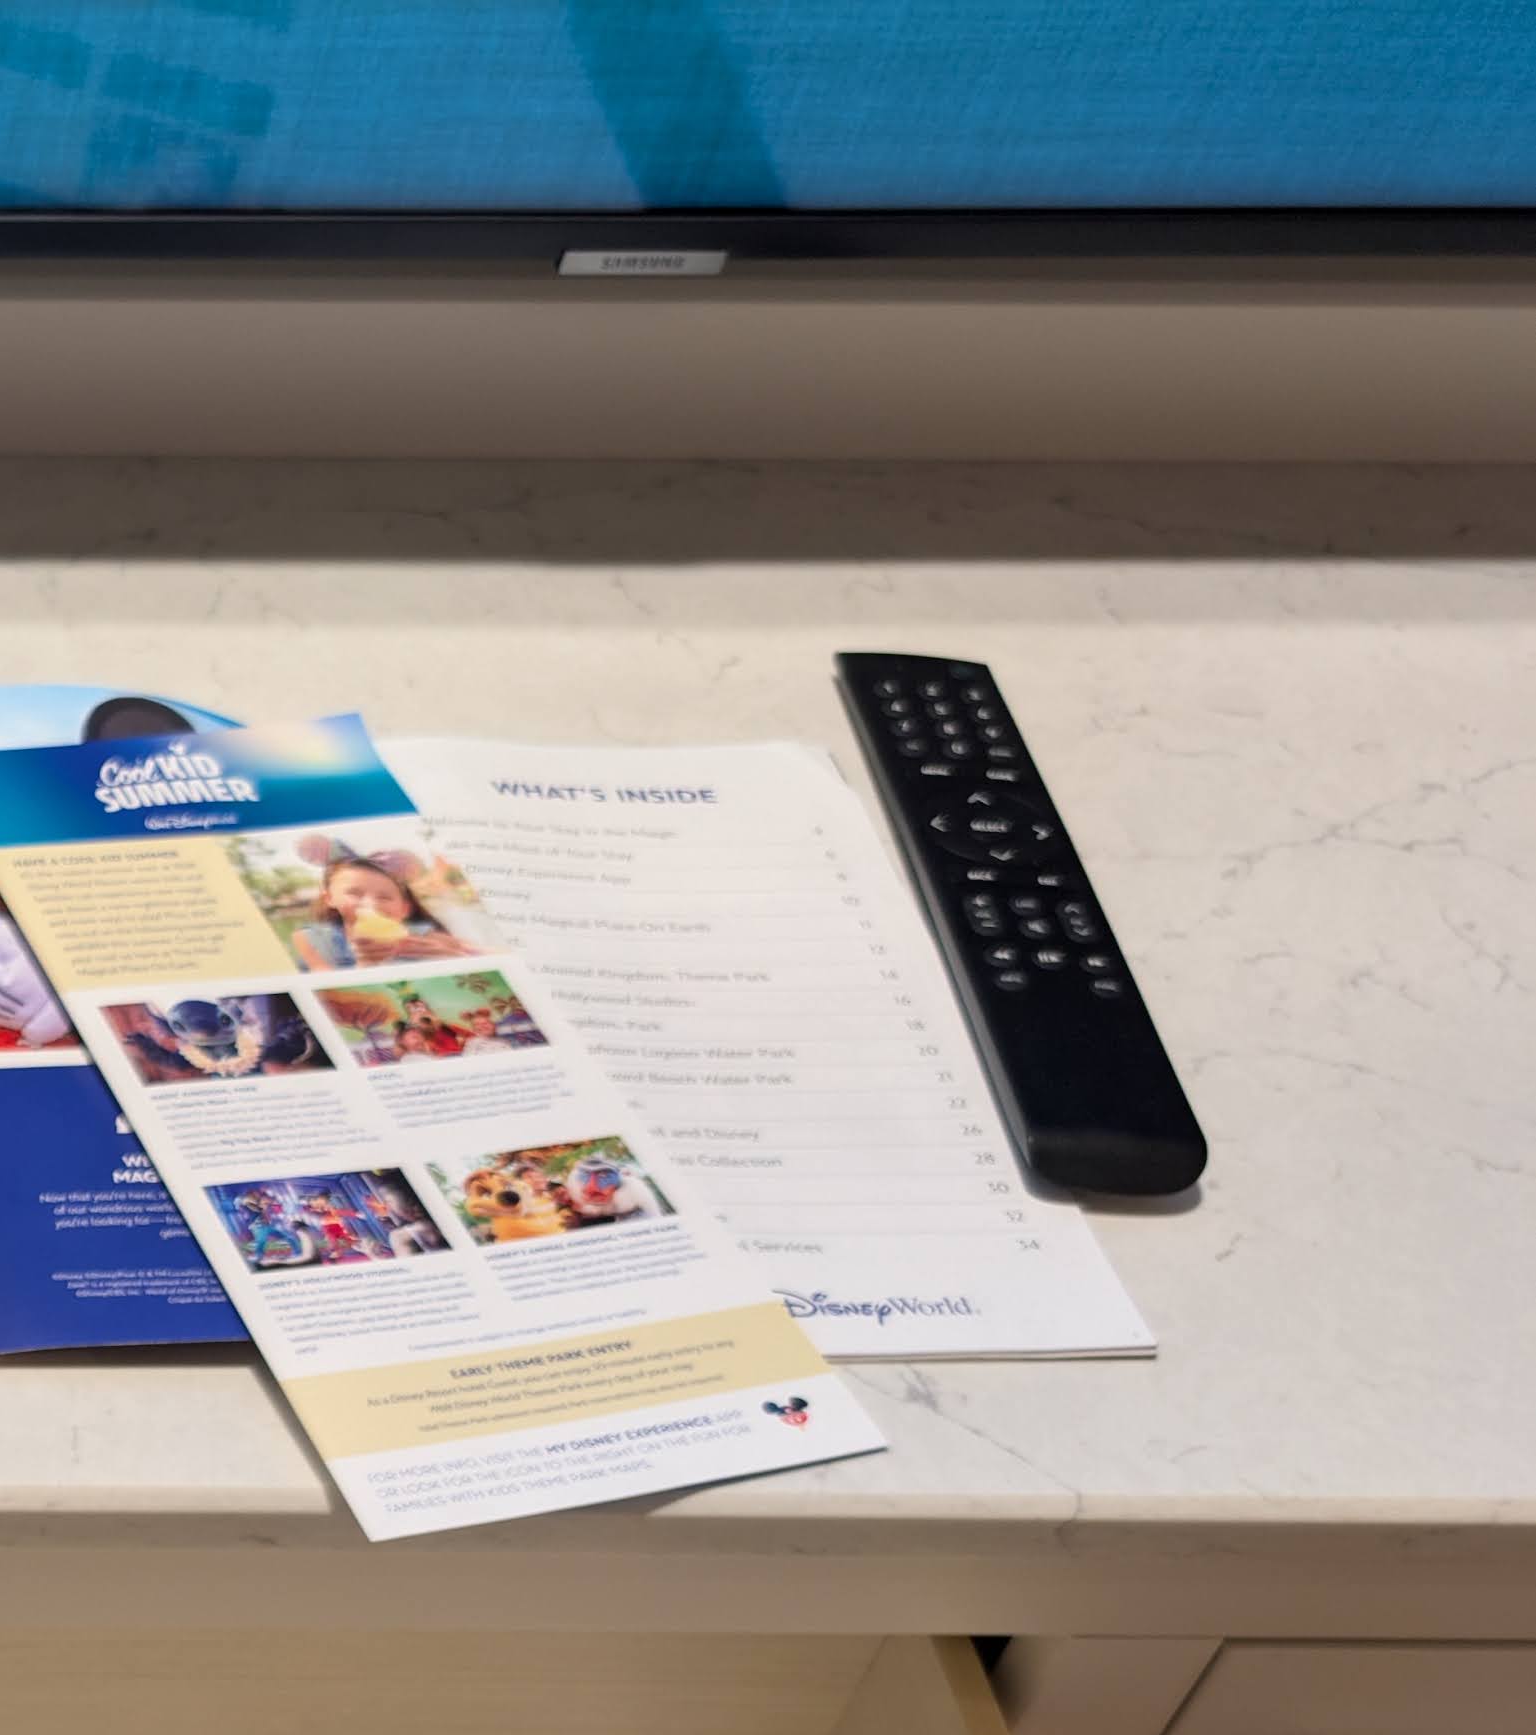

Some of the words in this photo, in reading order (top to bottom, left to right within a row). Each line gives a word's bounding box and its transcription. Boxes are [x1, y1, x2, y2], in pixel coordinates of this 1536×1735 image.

[601, 256, 685, 270] SAMSUNG
[97, 757, 158, 787] Cool
[155, 752, 221, 780] KID
[95, 777, 260, 813] SUMMER
[490, 779, 606, 803] WHAT'S
[617, 786, 719, 804] INSIDE
[772, 1287, 891, 1325] Disney
[450, 1364, 494, 1379] EARLY
[496, 1356, 544, 1371] THEME
[546, 1349, 585, 1362] PARK
[586, 1341, 635, 1355] ENTRY
[543, 1440, 569, 1453] MY
[568, 1431, 624, 1448] DISNEY
[624, 1416, 713, 1438] EXPERIENCE
